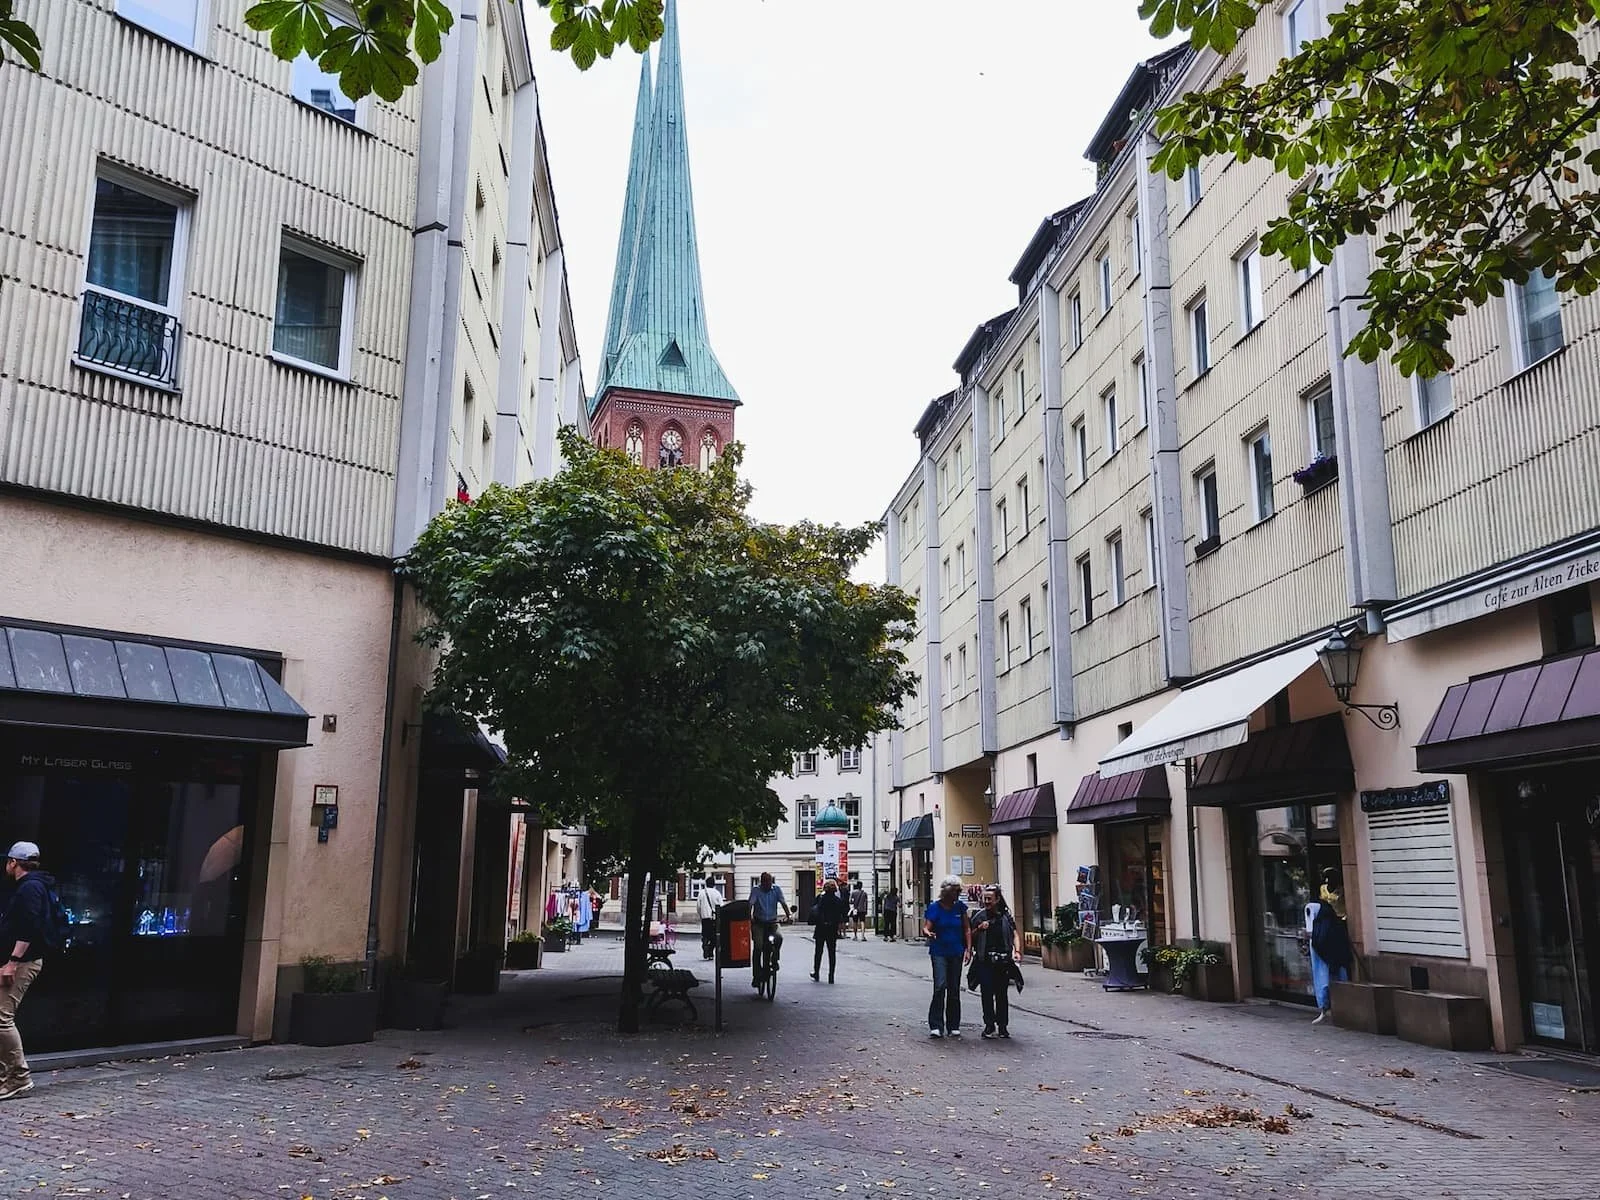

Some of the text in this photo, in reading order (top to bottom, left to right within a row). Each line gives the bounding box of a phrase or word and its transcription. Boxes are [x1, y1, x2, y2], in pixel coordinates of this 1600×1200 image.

[1484, 559, 1600, 609] Café zur Alten Zicke
